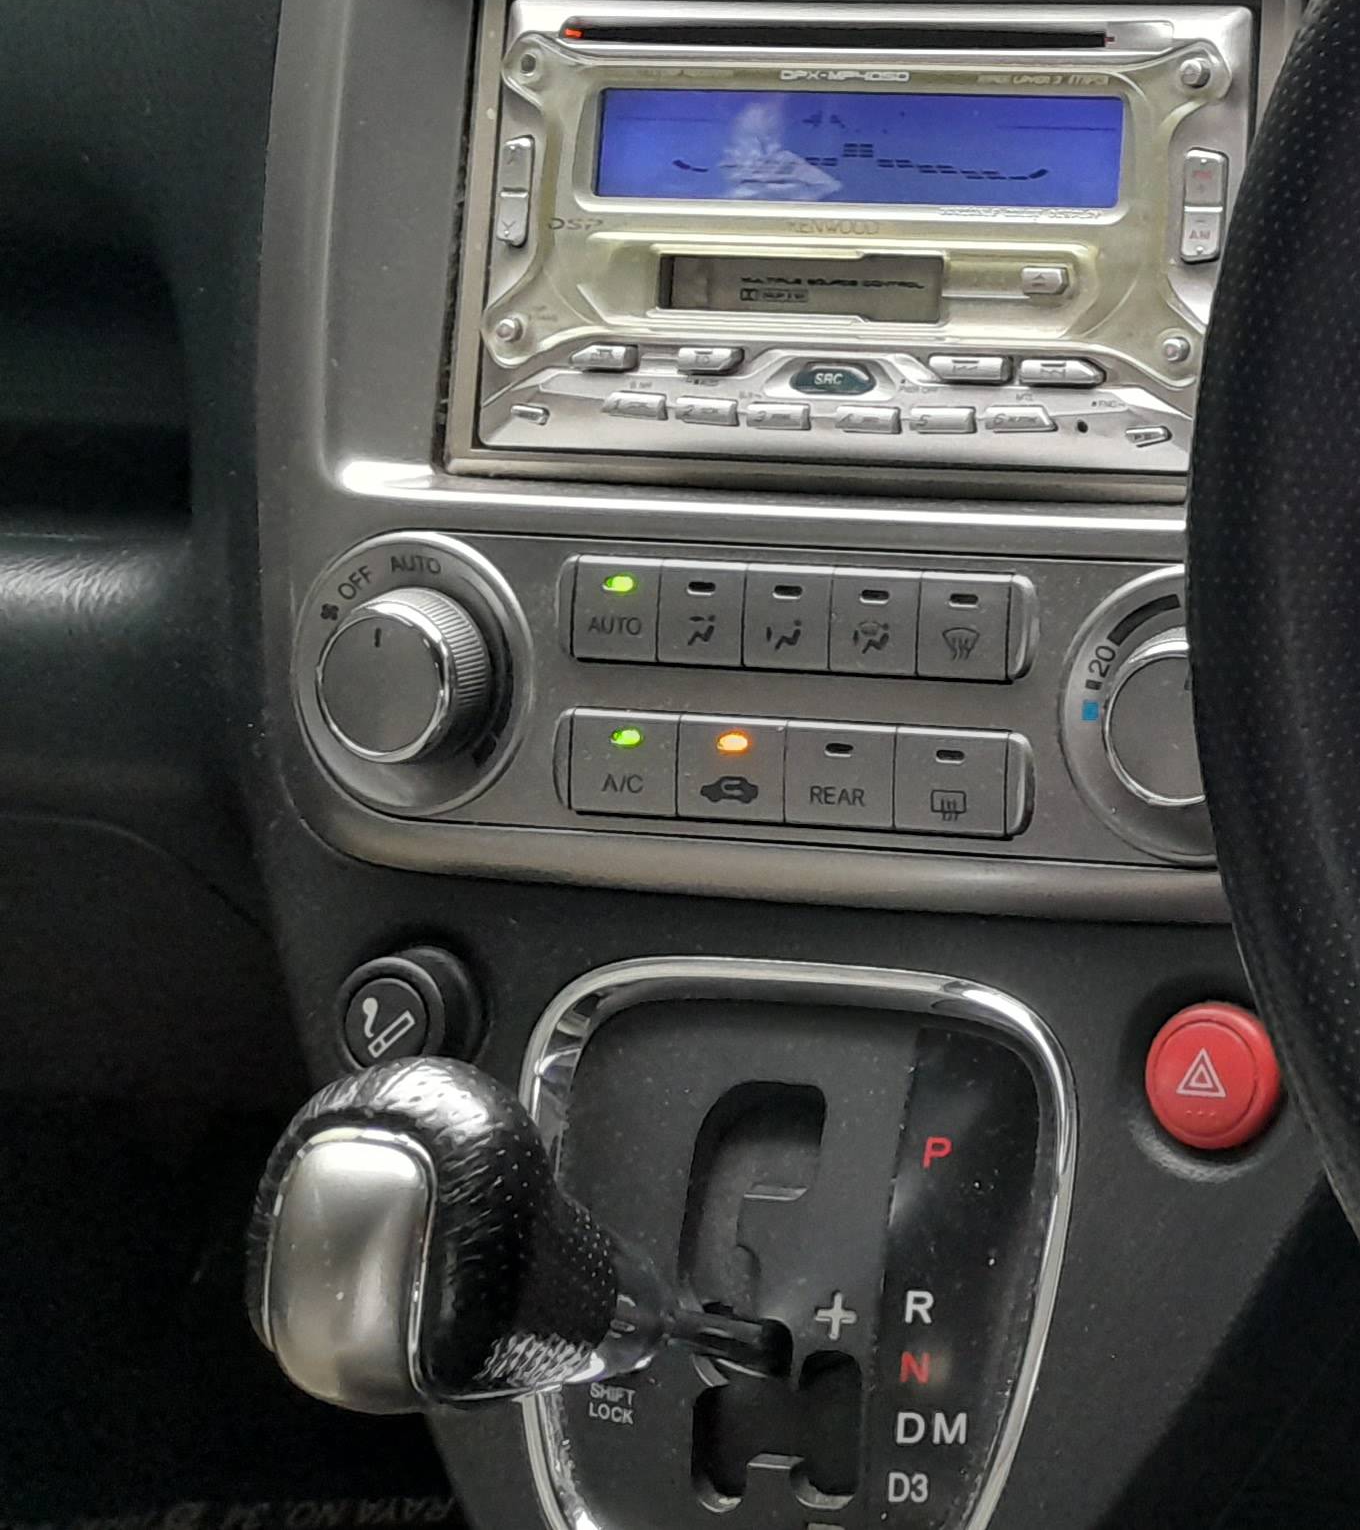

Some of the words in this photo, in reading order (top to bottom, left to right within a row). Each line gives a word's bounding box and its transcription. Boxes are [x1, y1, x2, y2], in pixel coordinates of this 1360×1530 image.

[548, 217, 604, 231] DSP
[785, 219, 880, 235] KENWOOD
[814, 372, 844, 386] SRC
[390, 554, 442, 576] AUTO
[337, 563, 373, 602] OFF
[587, 614, 642, 638] AUTO
[1088, 645, 1116, 678] 20
[601, 772, 644, 796] A/C
[808, 784, 866, 808] REAR
[922, 1136, 953, 1169] P
[904, 1290, 935, 1325] R
[899, 1351, 931, 1384] N
[589, 1382, 636, 1406] SHIFT
[588, 1402, 634, 1425] LOCK
[887, 1471, 929, 1504] D3
